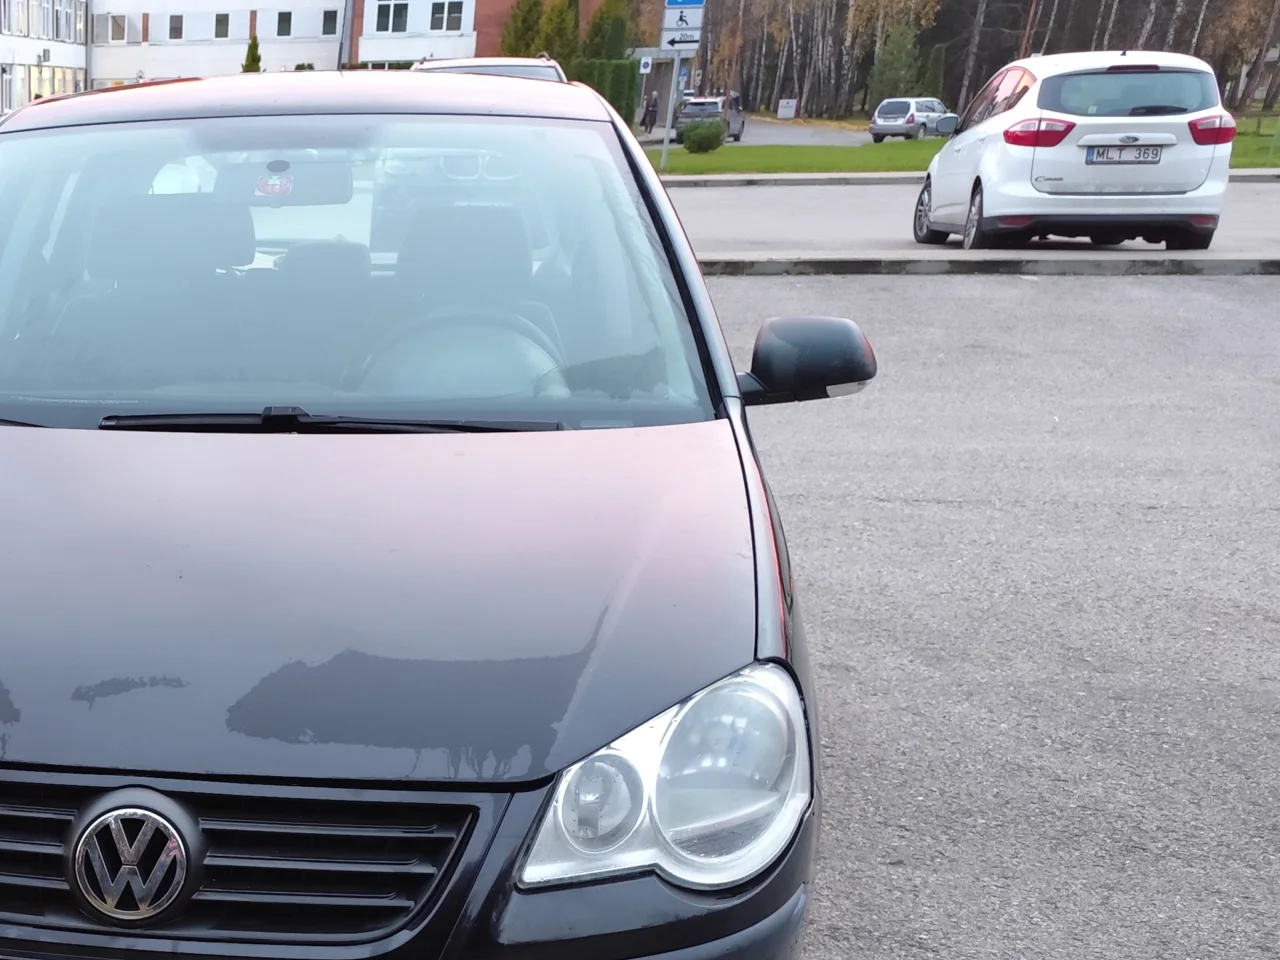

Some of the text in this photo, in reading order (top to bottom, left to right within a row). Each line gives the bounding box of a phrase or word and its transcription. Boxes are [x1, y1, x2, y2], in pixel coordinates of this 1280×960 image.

[1095, 148, 1126, 160] MLT
[1134, 148, 1159, 160] 369
[76, 808, 186, 919] VW
